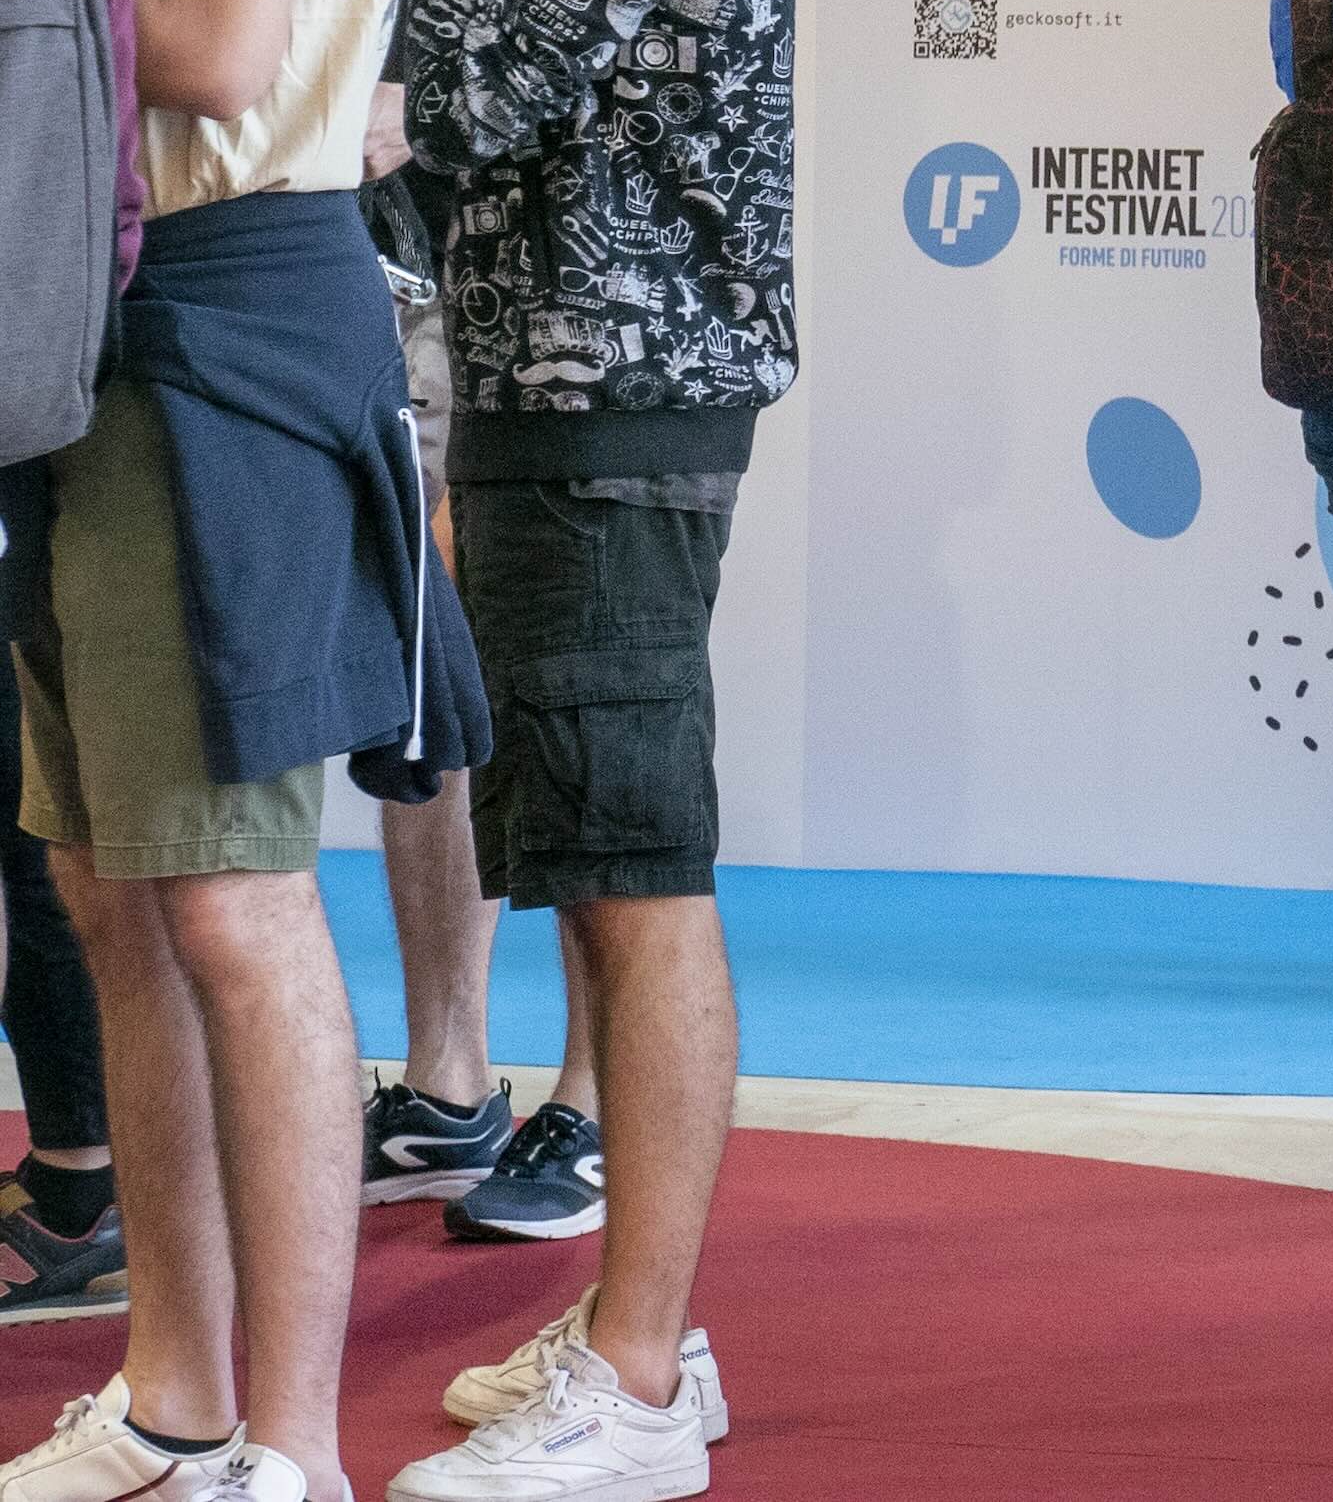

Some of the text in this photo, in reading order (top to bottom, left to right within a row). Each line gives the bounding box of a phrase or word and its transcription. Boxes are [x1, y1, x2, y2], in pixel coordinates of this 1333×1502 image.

[1005, 11, 1123, 30] geckosoft.it
[1031, 147, 1204, 191] INTERNET
[1045, 194, 1255, 238] FESTIVAL 20
[1059, 246, 1206, 269] FORME DI FUTURO
